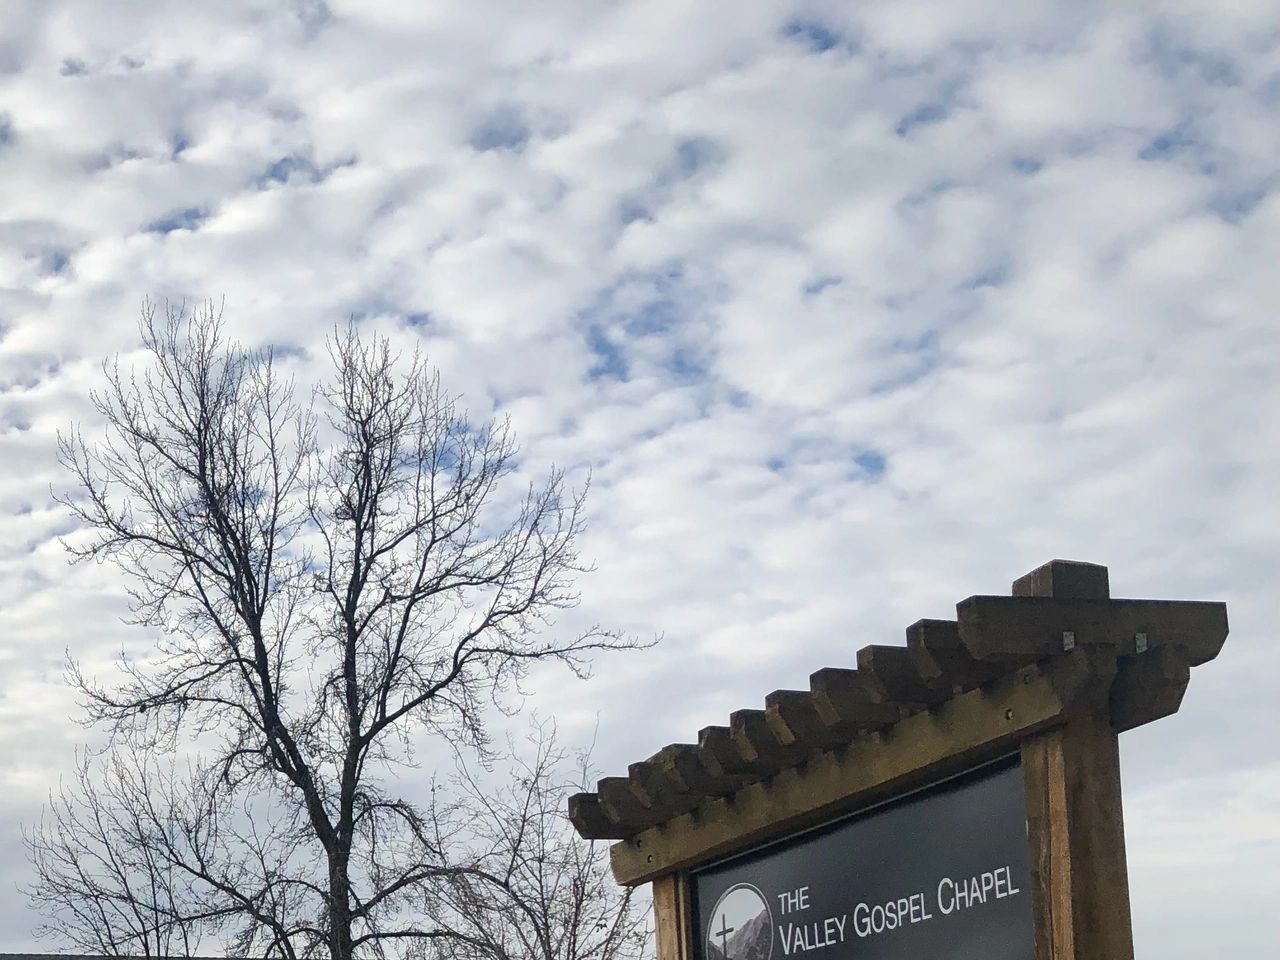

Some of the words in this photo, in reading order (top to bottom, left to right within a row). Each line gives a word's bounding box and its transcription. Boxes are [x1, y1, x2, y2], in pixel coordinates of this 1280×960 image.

[778, 886, 810, 915] THE
[779, 915, 847, 955] VALLEY
[853, 892, 933, 938] GOSPEL
[937, 866, 1020, 915] CHAPEL
